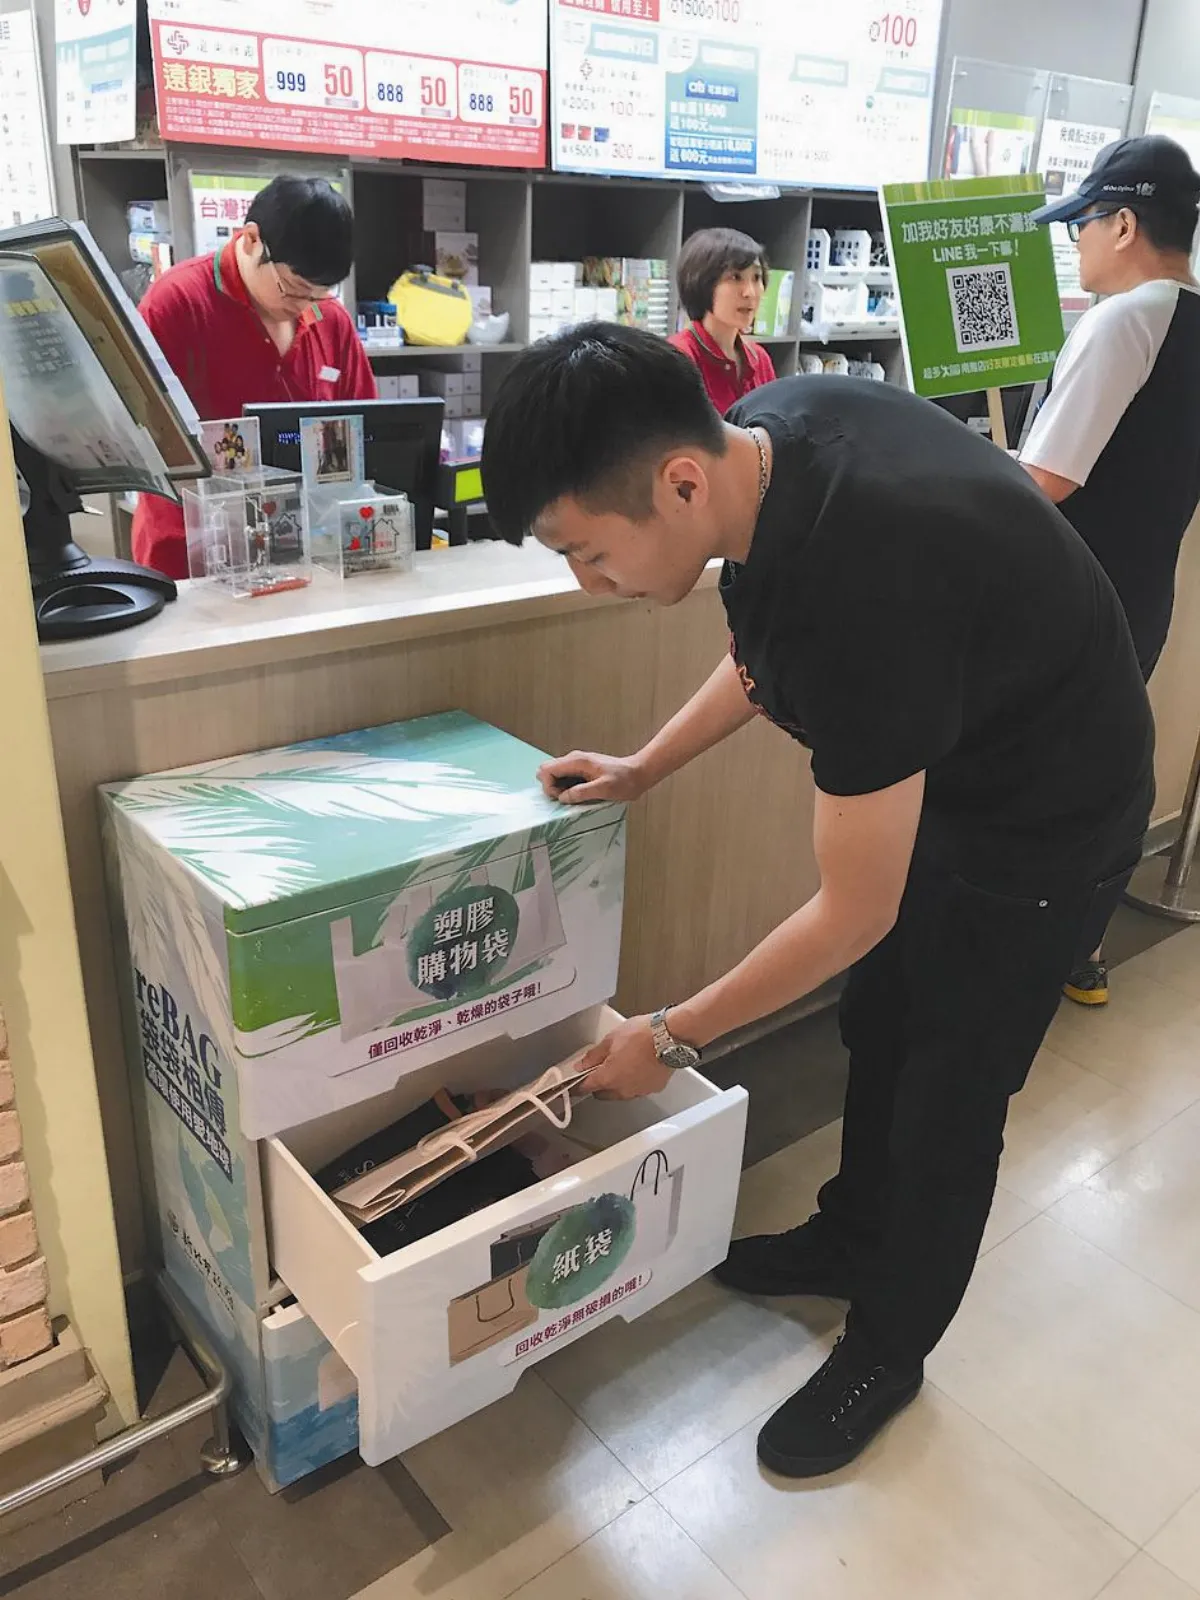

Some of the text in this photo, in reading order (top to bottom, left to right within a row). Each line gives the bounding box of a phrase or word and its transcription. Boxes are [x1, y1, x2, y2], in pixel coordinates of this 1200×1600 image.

[882, 13, 917, 47] 100
[162, 61, 260, 100] 遠銀獨家
[276, 71, 306, 92] 999
[324, 64, 353, 97] 50
[377, 76, 447, 107] 888 50
[469, 86, 533, 116] 888 50
[932, 246, 963, 263] LINE
[432, 896, 494, 946] 塑膠
[416, 928, 509, 989] 購物袋
[134, 967, 222, 1090] reBAG
[551, 1228, 613, 1284] 紙袋
